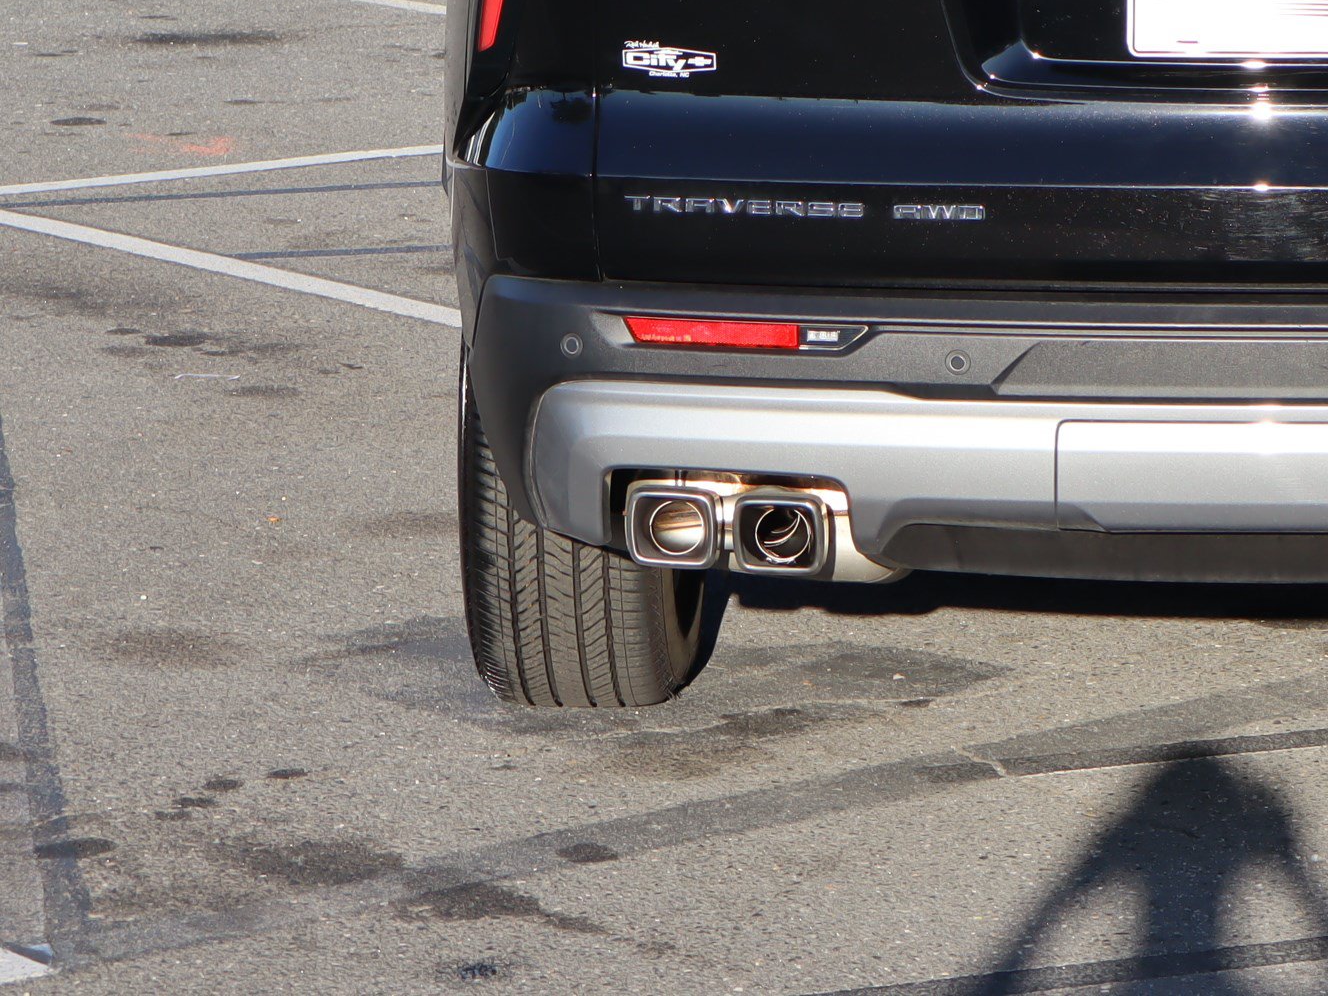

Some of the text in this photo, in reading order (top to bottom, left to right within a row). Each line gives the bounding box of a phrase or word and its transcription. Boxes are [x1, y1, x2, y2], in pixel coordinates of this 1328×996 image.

[626, 50, 686, 72] City
[624, 195, 986, 220] TRAVERSE AWD
